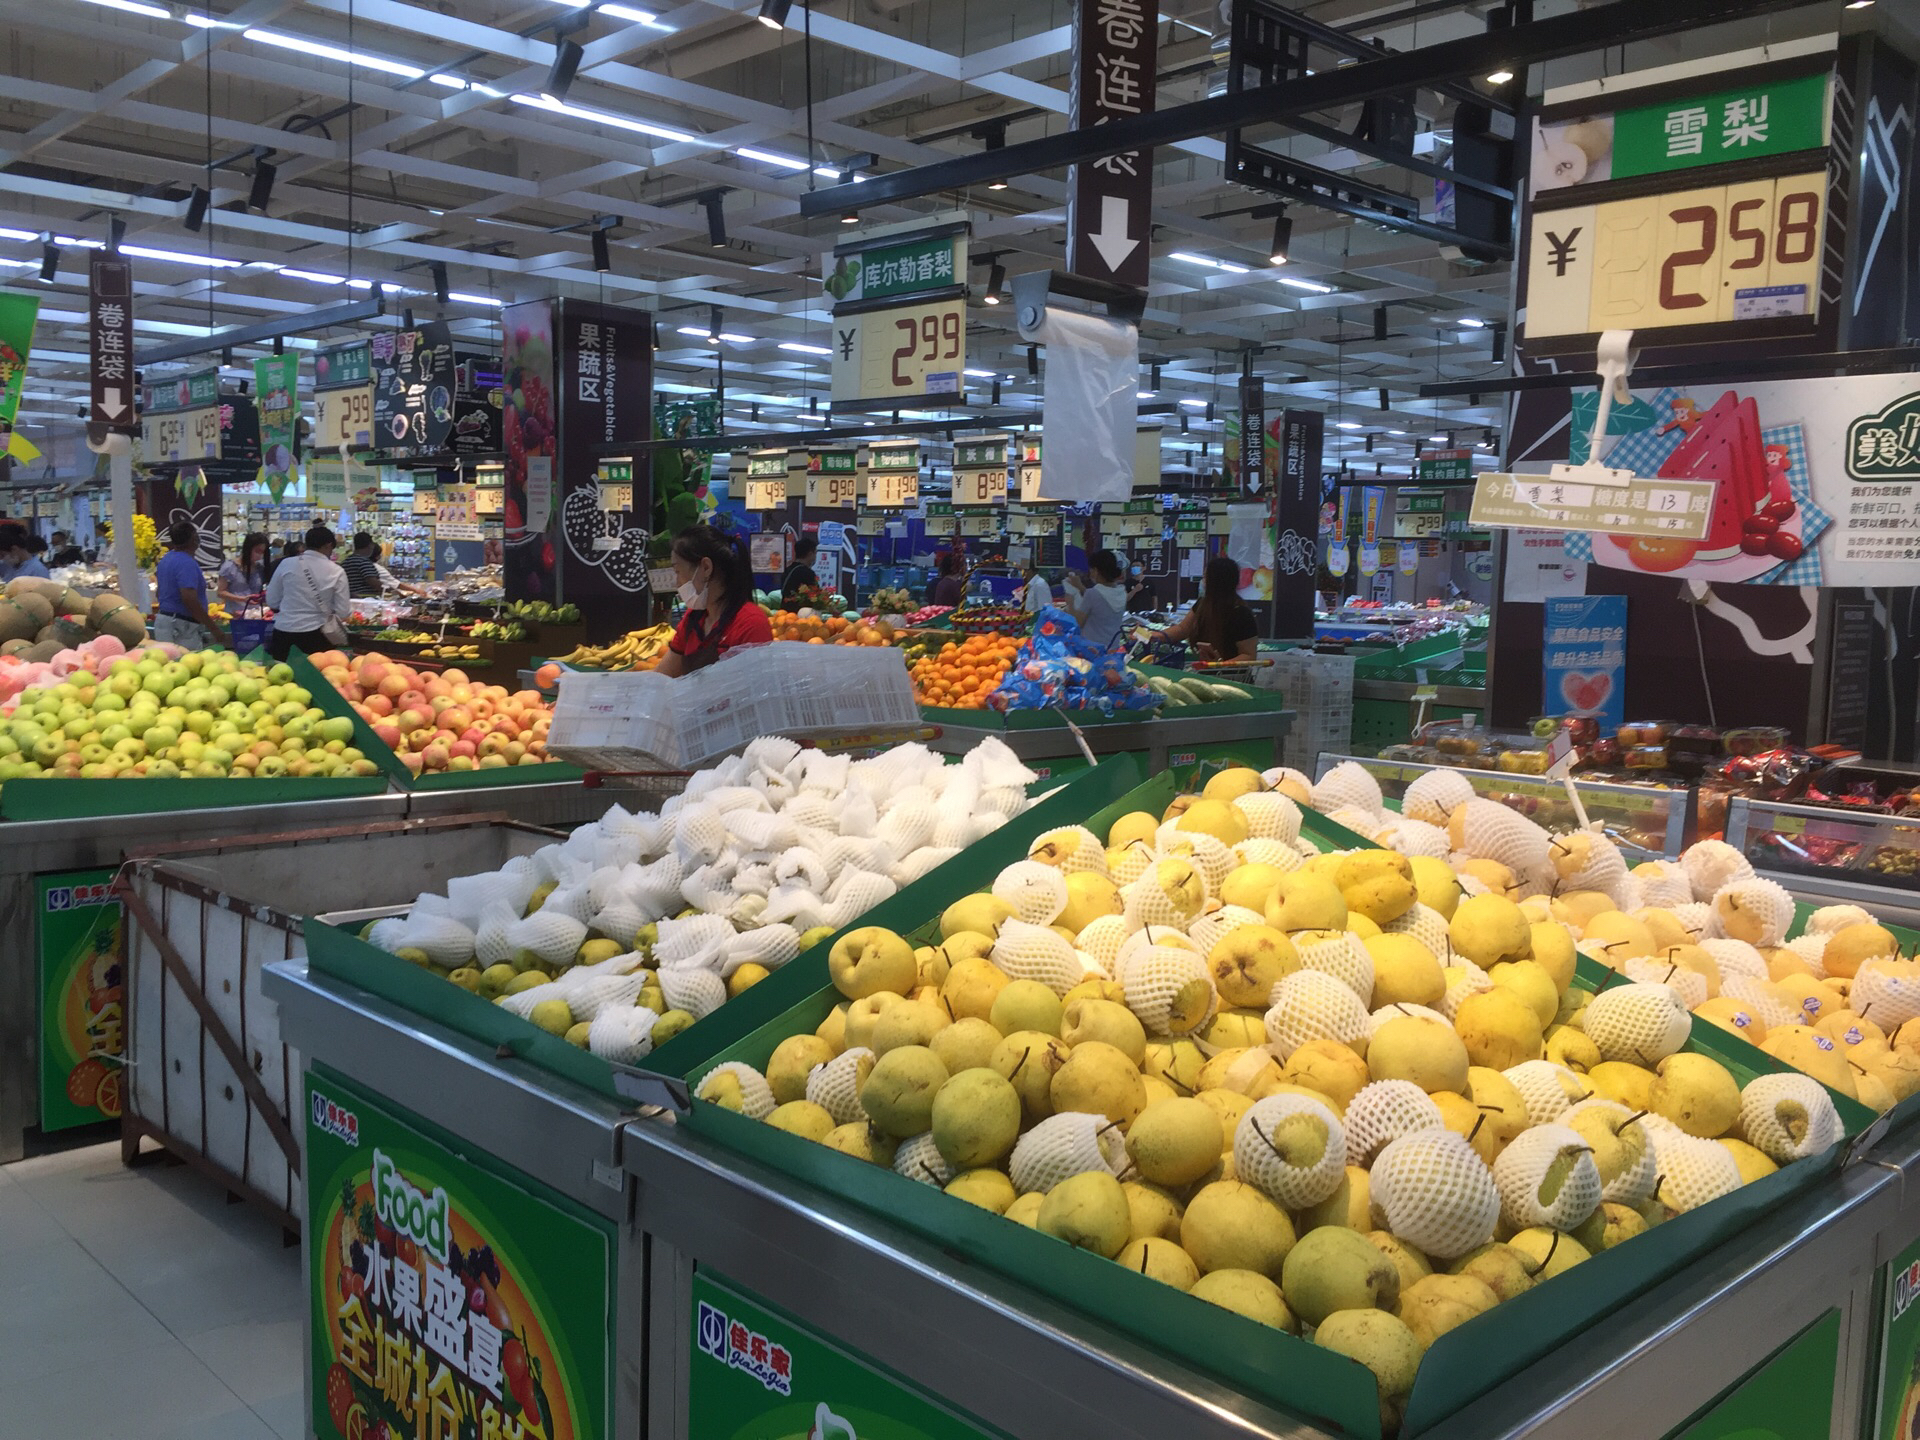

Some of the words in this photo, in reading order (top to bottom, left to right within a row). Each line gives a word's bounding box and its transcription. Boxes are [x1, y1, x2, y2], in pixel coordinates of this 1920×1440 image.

[1664, 95, 1769, 157] 雪梨
[864, 249, 952, 289] 库尔勒香梨
[1544, 227, 1583, 277] ¥
[98, 303, 125, 379] 卷连袋
[578, 322, 601, 402] 果蔬区
[838, 328, 856, 361] ¥
[603, 326, 616, 442] Fruits&Vegetables
[1246, 413, 1262, 467] 卷连袋
[1287, 423, 1299, 475] 果蔬区
[1485, 482, 1515, 499] 今日
[1594, 488, 1647, 510] 糖度是
[1659, 494, 1676, 511] 13
[1689, 494, 1710, 514] 度
[1850, 486, 1913, 497] 我们为您提供
[1552, 626, 1624, 643] 聚焦食品安全
[1552, 650, 1624, 667] 提升生活品质
[373, 1150, 449, 1262] Food
[363, 1240, 503, 1401] 水果盛宴
[730, 1322, 790, 1378] 佳乐家
